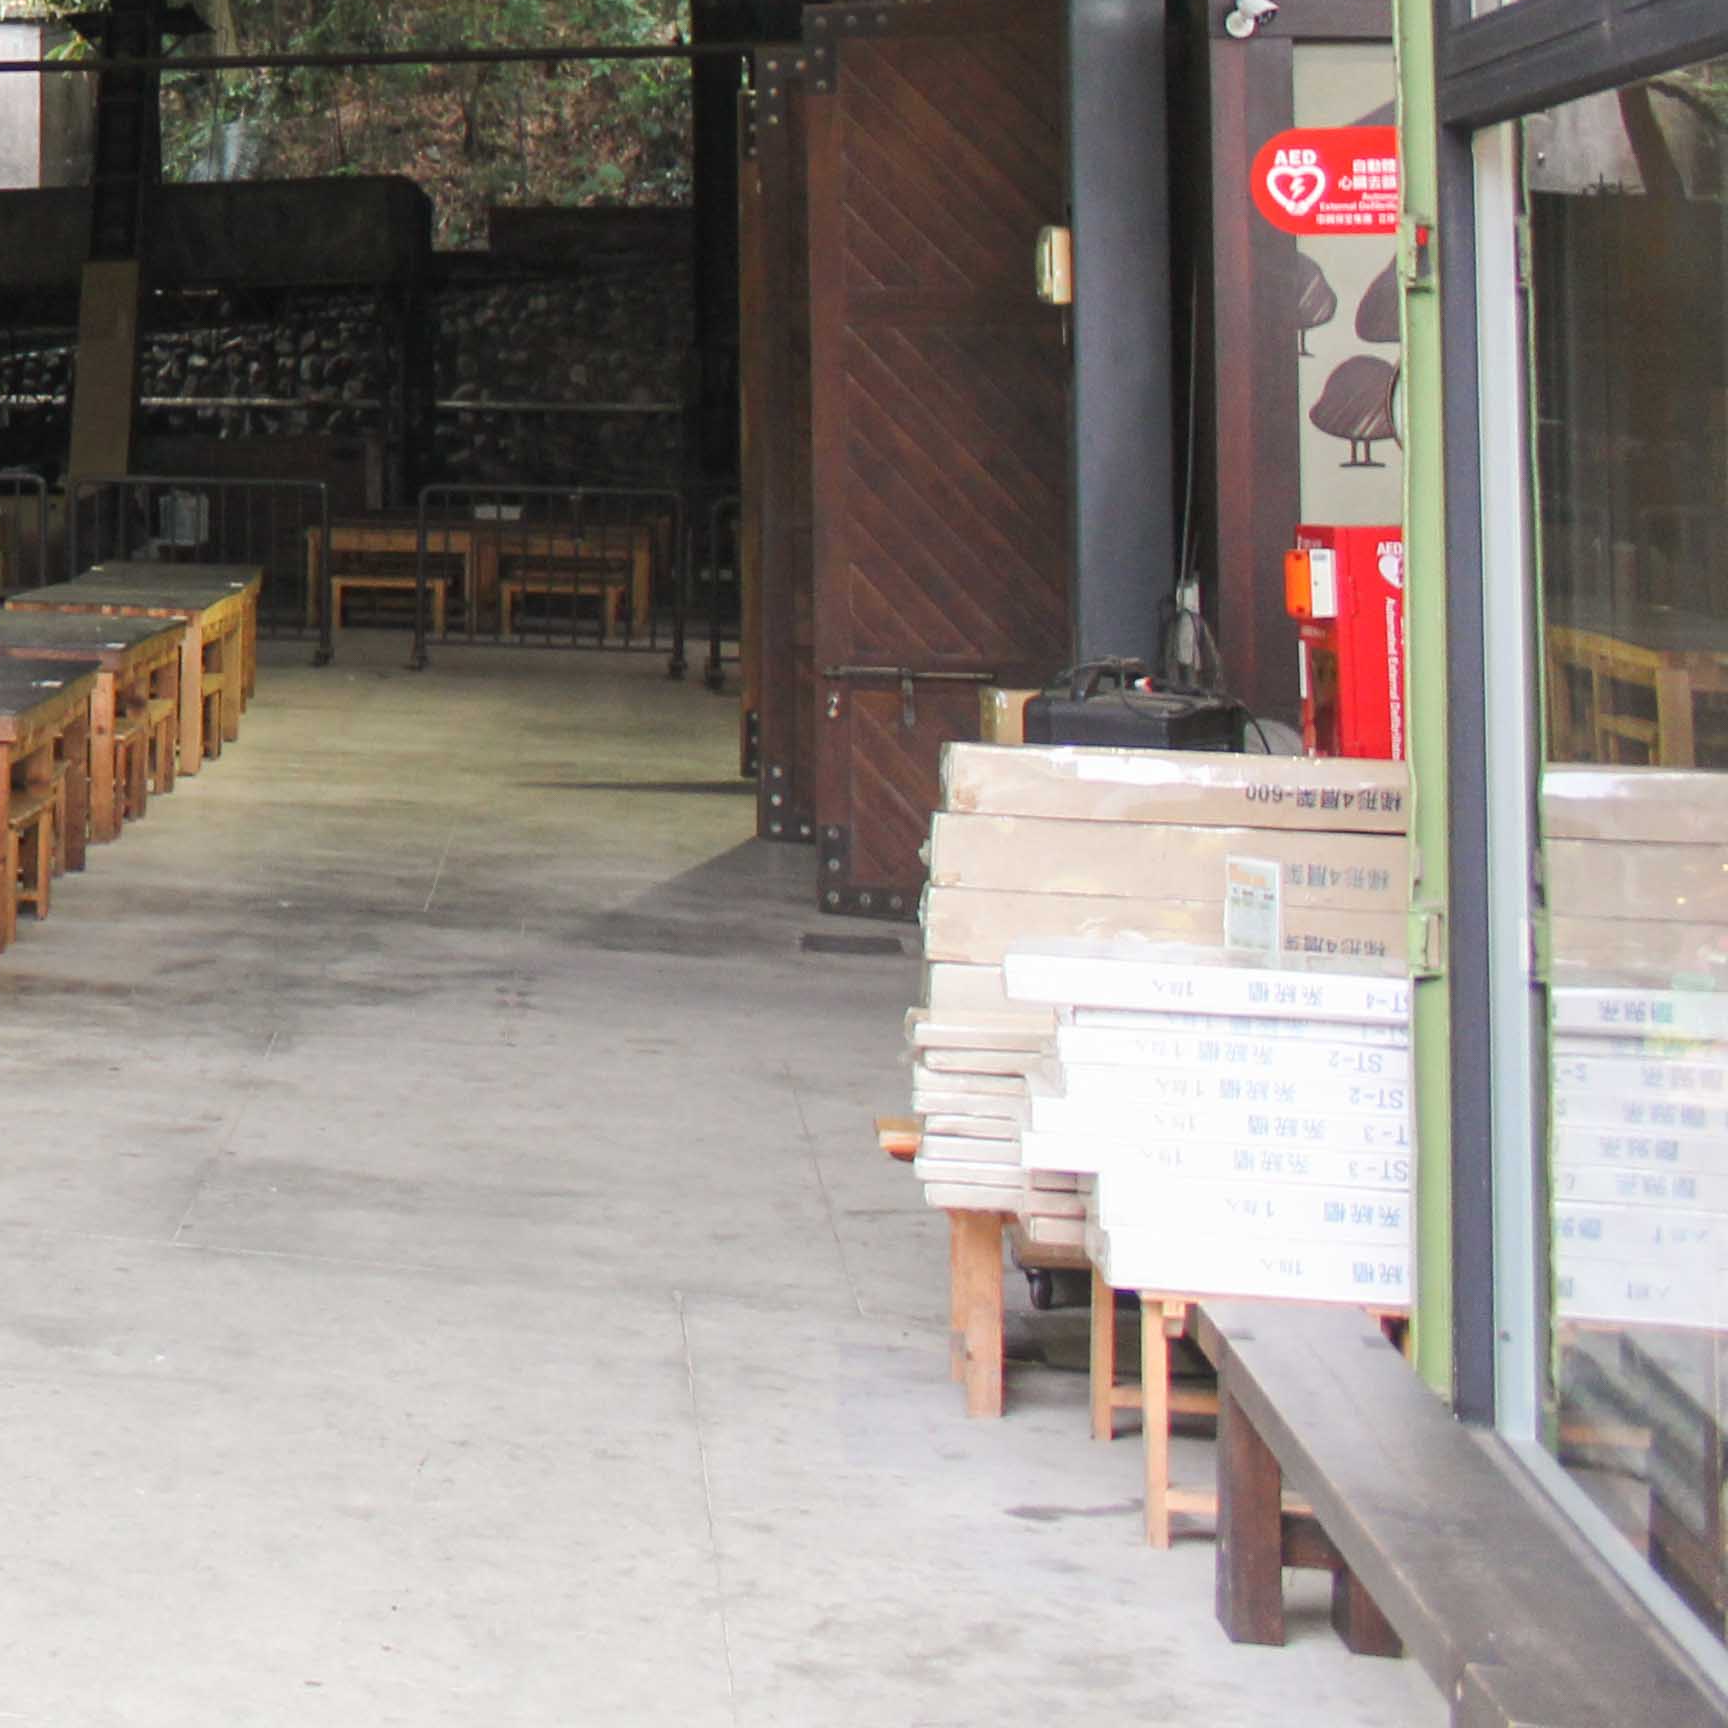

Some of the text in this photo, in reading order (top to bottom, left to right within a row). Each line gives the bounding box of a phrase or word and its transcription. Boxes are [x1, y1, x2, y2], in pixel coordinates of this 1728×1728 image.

[1274, 149, 1317, 165] AED
[1328, 1050, 1383, 1073] ST-2
[1350, 1086, 1404, 1109] ST-2
[1349, 1159, 1408, 1183] ST-3
